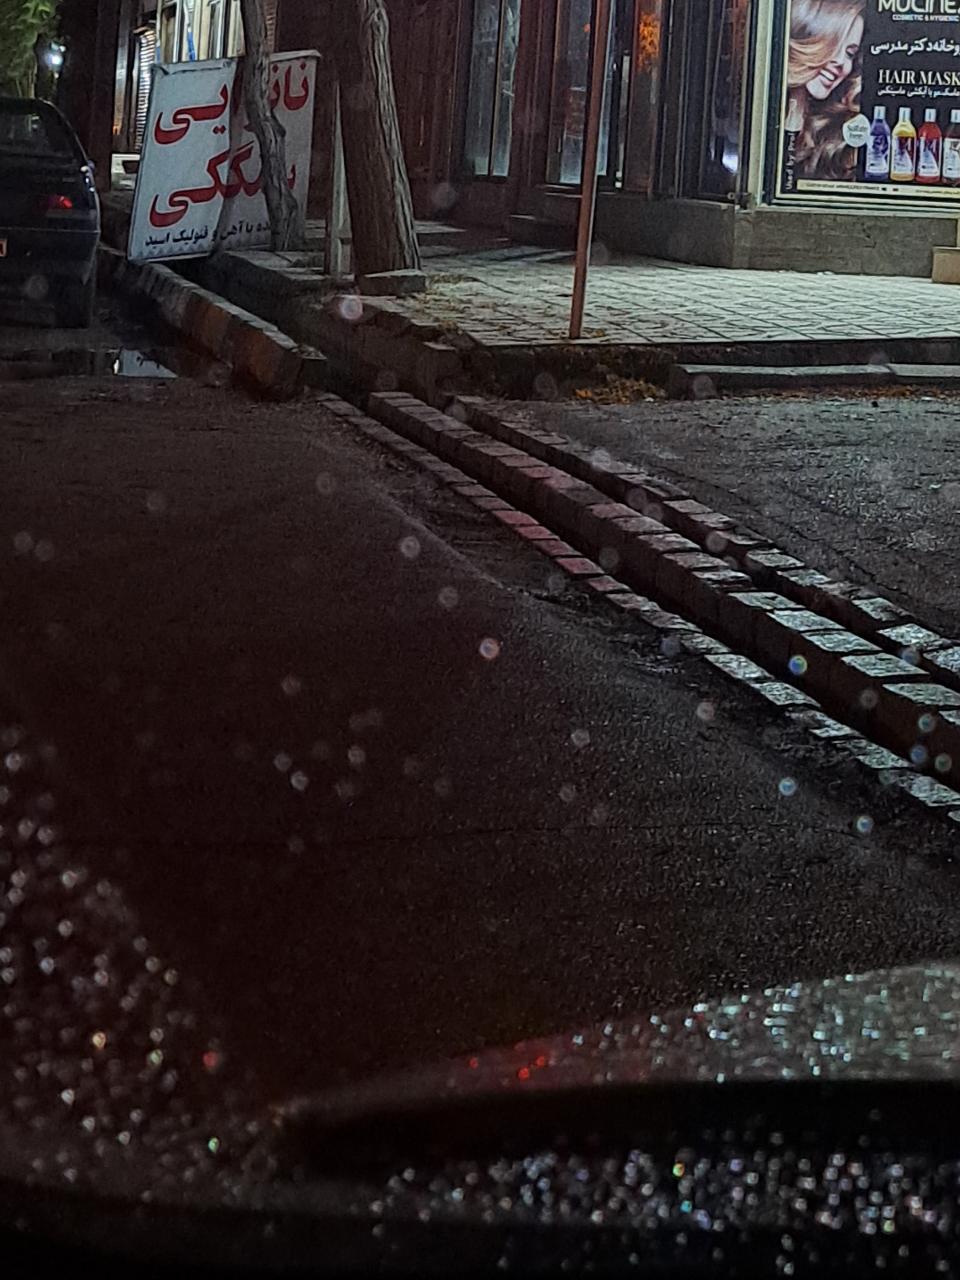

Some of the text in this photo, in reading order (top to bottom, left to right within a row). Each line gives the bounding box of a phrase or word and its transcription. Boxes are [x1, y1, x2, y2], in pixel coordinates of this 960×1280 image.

[870, 40, 909, 55] مدرسی
[907, 37, 933, 56] دکتر
[878, 69, 916, 84] HAIR
[154, 62, 309, 145] نانایی
